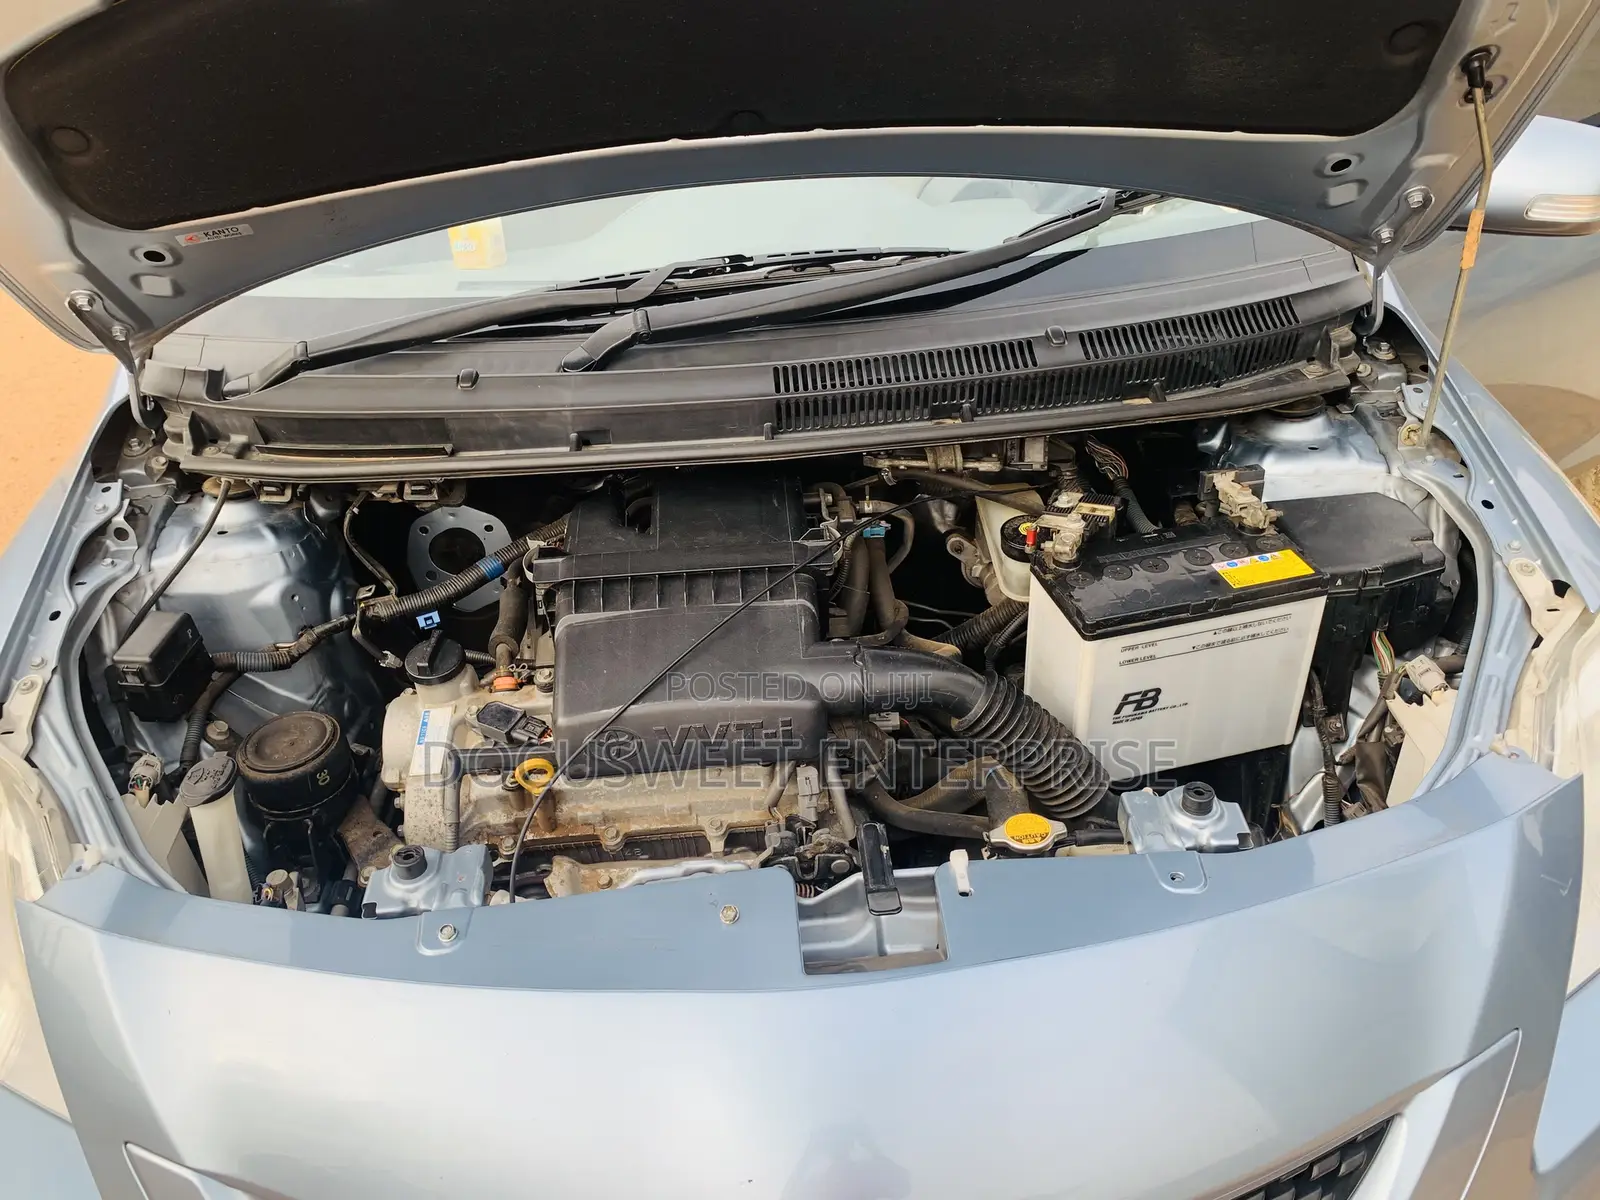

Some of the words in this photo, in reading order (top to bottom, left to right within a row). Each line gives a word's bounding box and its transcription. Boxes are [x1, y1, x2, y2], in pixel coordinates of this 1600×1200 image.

[203, 227, 239, 237] KANTO
[1141, 641, 1158, 649] LEVEL
[1119, 657, 1139, 665] LOWER
[1113, 687, 1162, 715] FB
[652, 717, 793, 755] VVT-i
[1014, 832, 1047, 841] CAUTION
